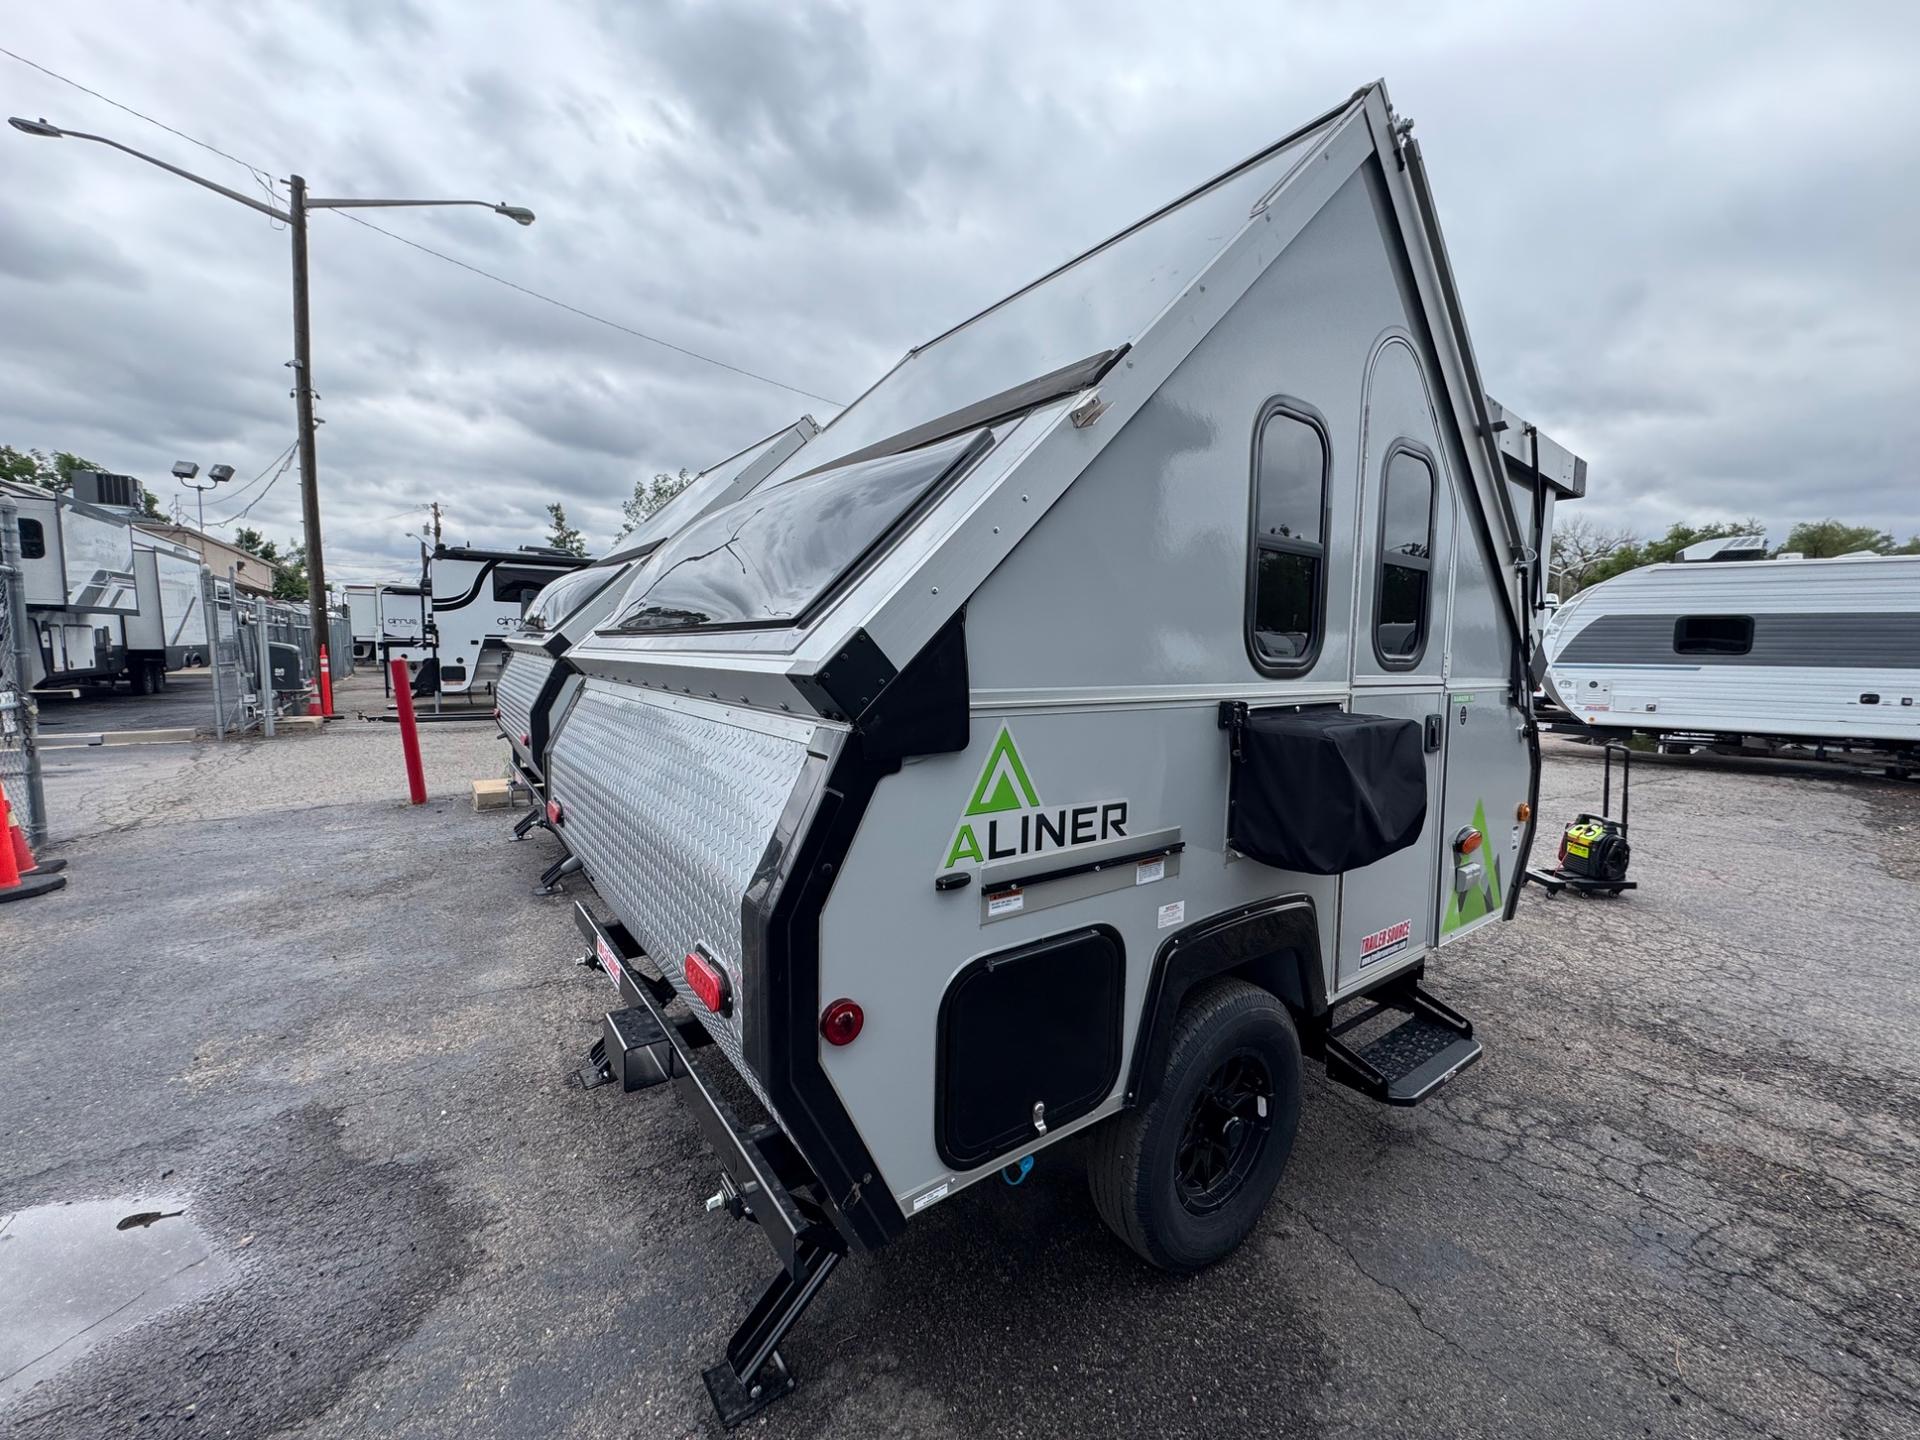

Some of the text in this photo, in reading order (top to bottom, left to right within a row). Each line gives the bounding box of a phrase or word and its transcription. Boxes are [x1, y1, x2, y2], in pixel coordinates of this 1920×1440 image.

[944, 802, 1128, 869] ALINER
[1361, 930, 1387, 954] TRAILER
[1386, 921, 1410, 943] SOURCE
